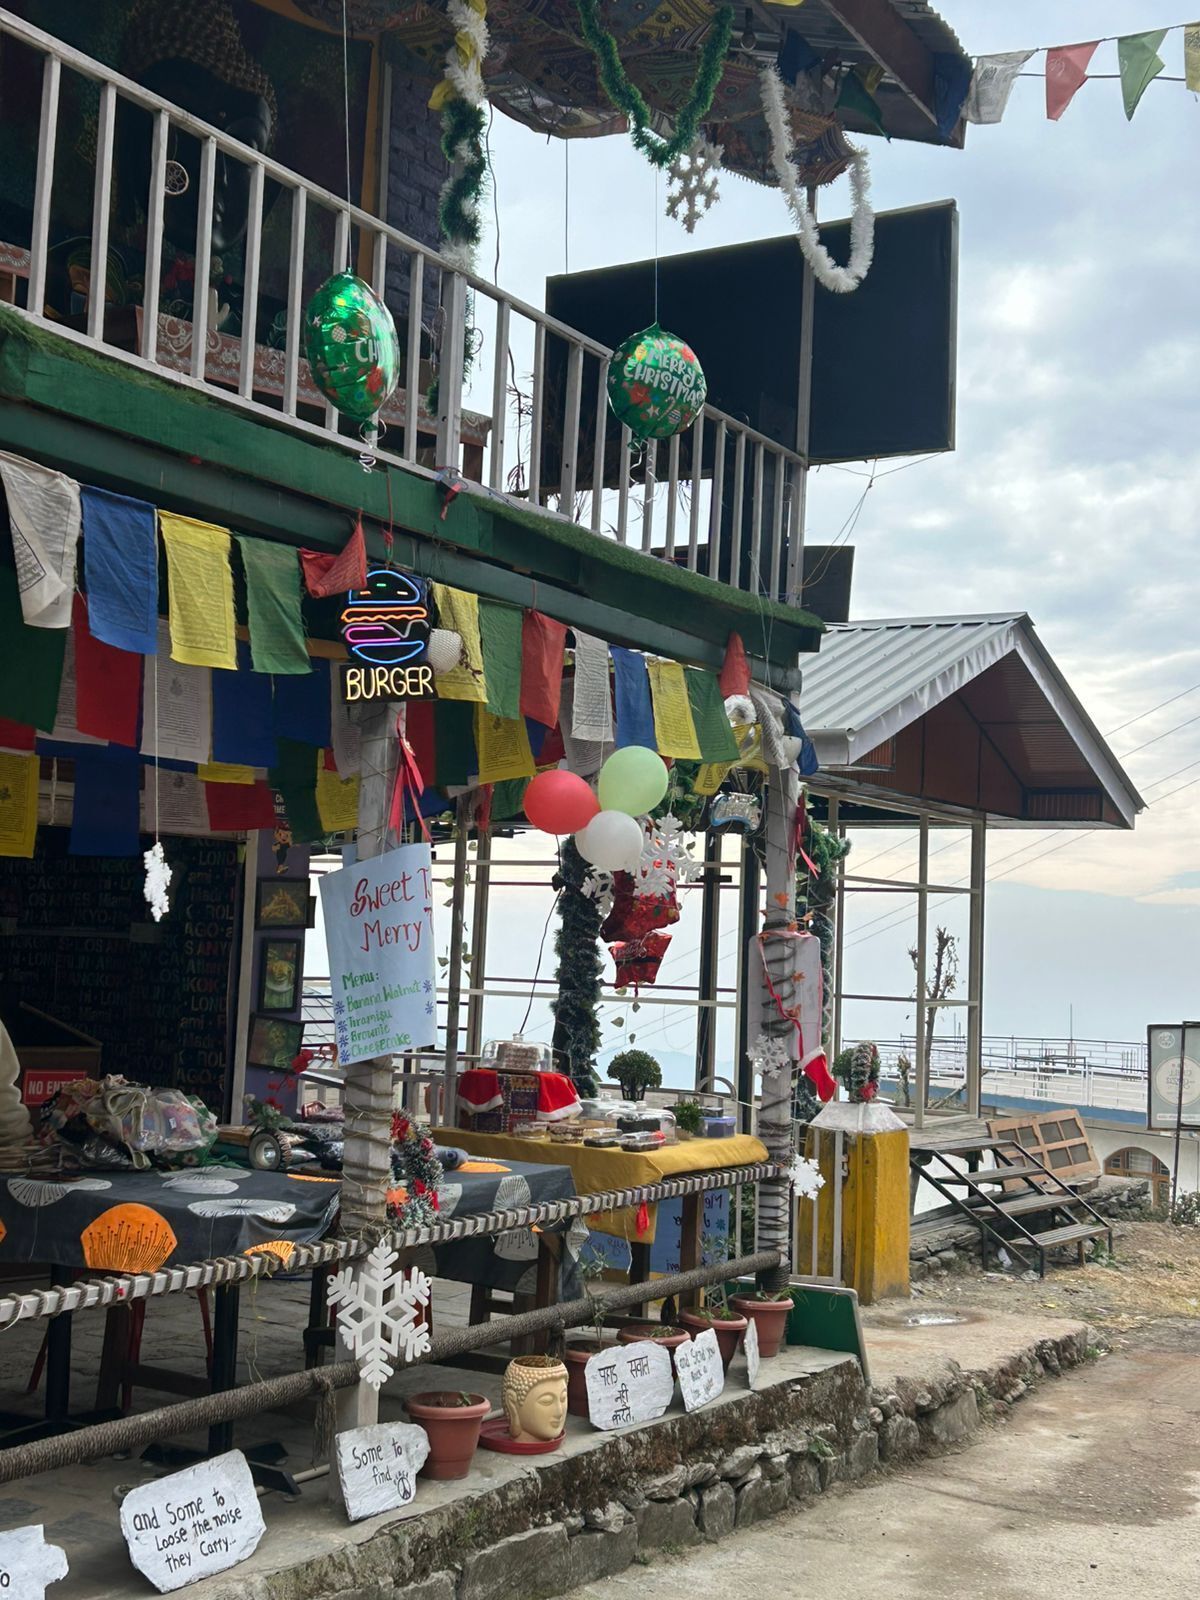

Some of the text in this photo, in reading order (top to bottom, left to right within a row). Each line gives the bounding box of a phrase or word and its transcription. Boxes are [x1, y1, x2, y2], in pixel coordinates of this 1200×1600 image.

[346, 665, 434, 700] BURGER
[349, 871, 415, 918] Sweet
[359, 919, 422, 953] Merry
[341, 971, 380, 991] Menu:
[28, 1080, 44, 1095] NO
[352, 1437, 403, 1470] Some to
[372, 1465, 393, 1486] find
[132, 1487, 226, 1532] and Some to
[154, 1507, 243, 1552] Loose the noise
[164, 1551, 193, 1574] they
